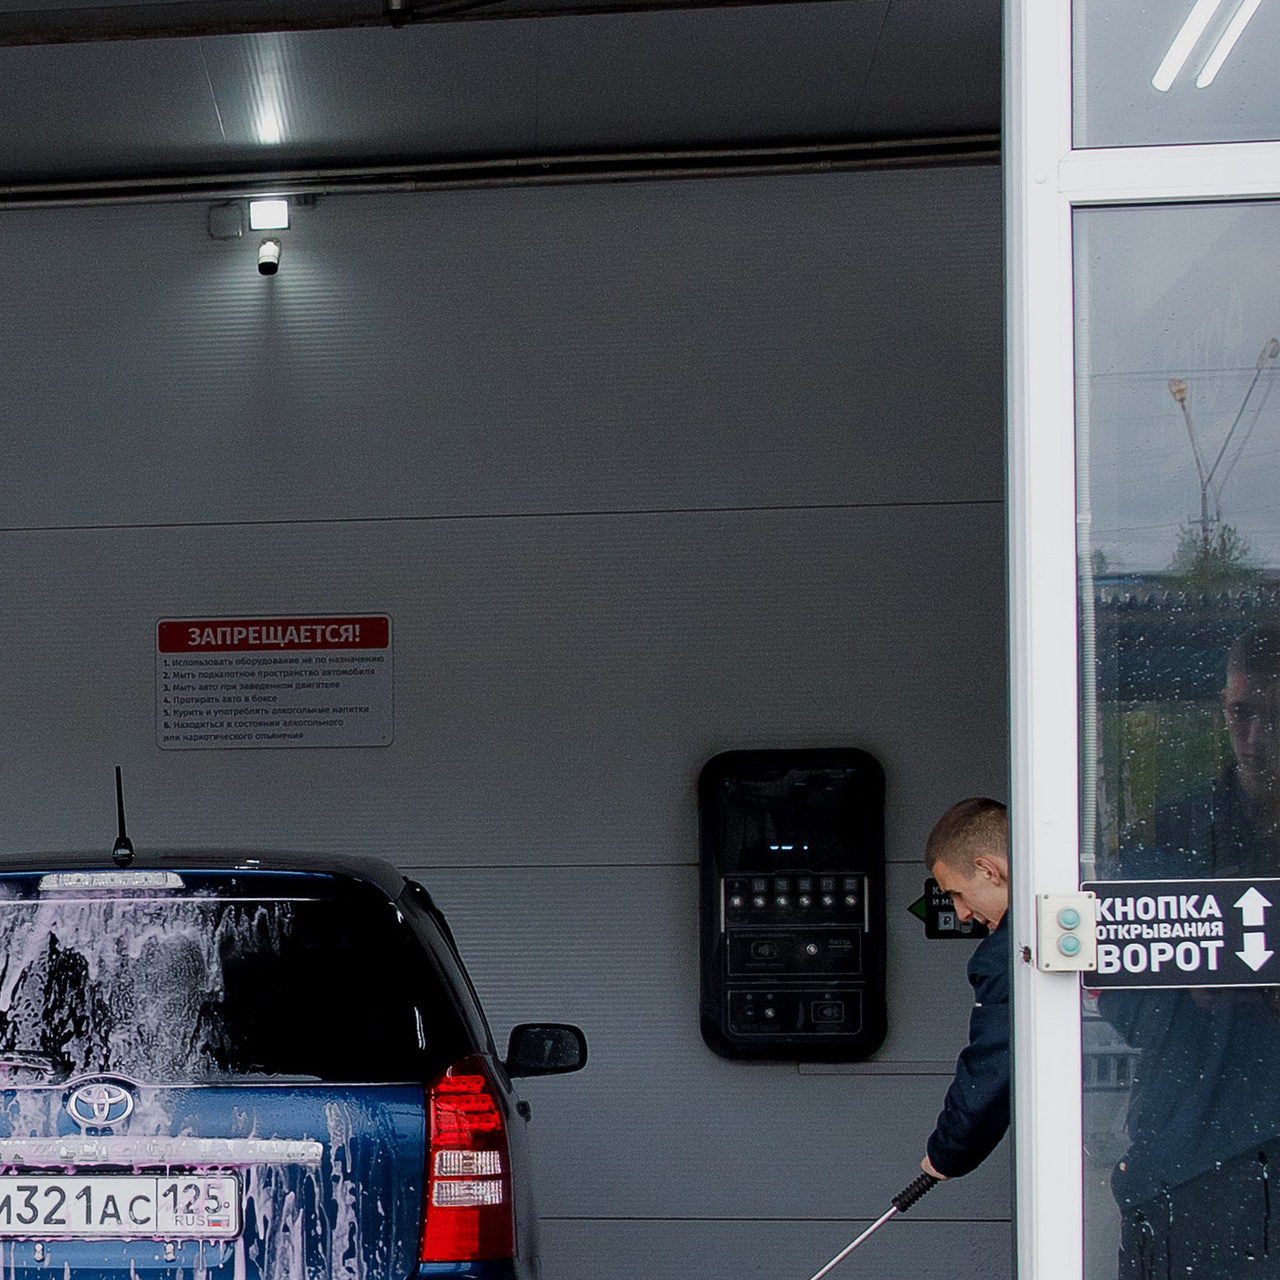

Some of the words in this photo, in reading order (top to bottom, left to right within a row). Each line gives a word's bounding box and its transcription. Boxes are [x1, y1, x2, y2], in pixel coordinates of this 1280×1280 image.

[187, 623, 361, 647] ЗАПРЕЩАЕТСЯ!
[172, 671, 196, 680] Мыть
[172, 683, 196, 692] Мыть
[1095, 893, 1224, 923] КНОПКА
[1095, 922, 1225, 941] ОТКРЫВАНИЯ
[1096, 939, 1225, 975] ВОРОТ
[164, 1183, 226, 1217] 125
[176, 1214, 208, 1228] RUS
